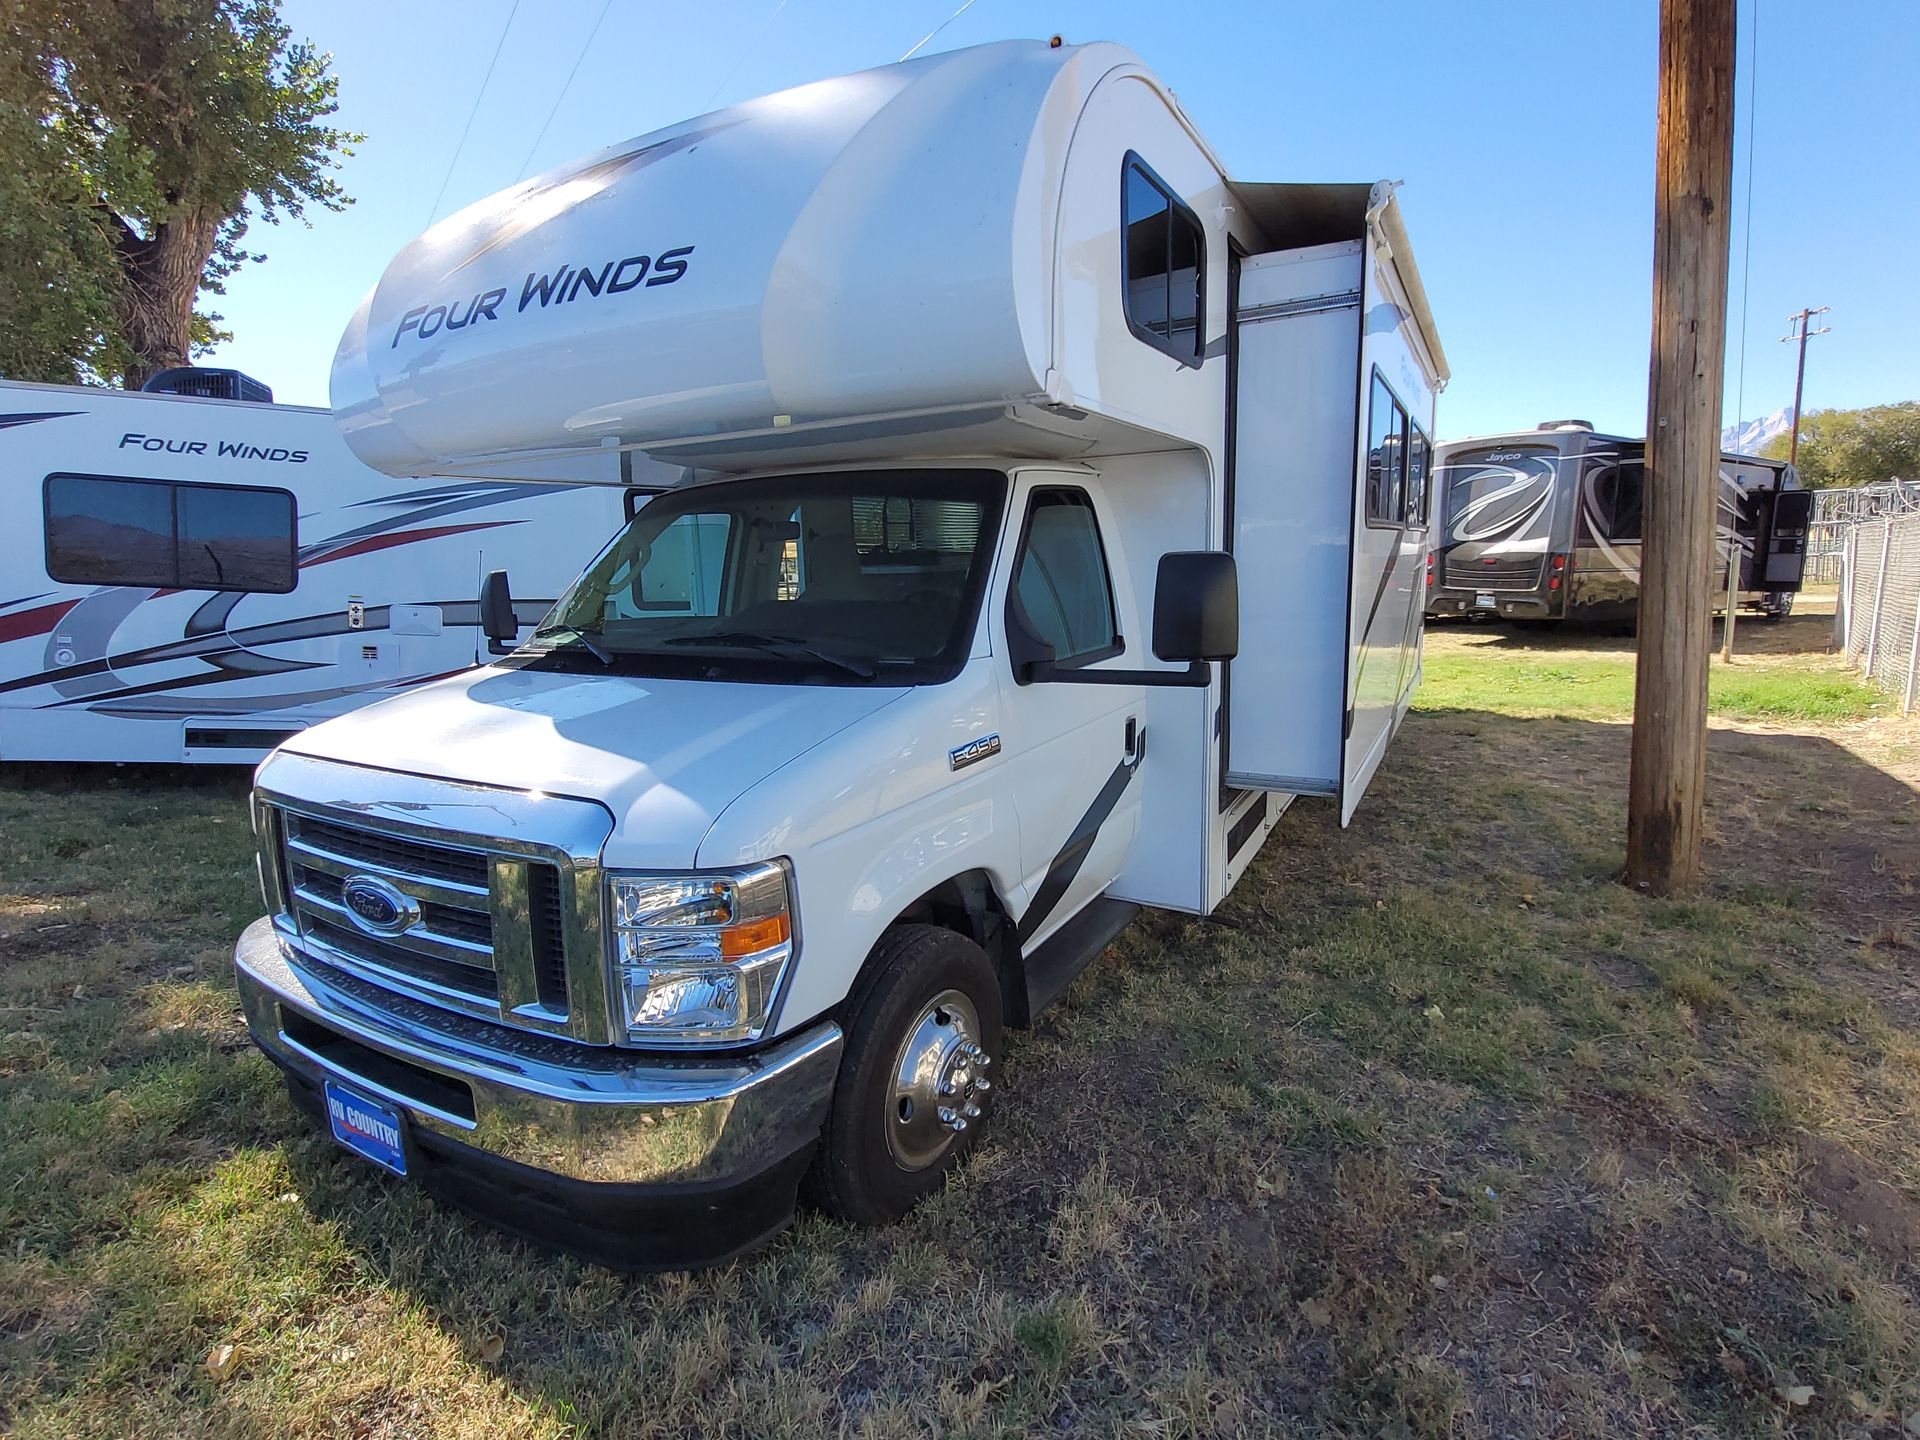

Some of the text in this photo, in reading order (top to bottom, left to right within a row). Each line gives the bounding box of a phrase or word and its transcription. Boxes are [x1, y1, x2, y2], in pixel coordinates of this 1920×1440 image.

[391, 246, 695, 349] FOUR WINDS
[118, 433, 310, 464] FOUR WINDS
[1485, 453, 1521, 463] Jayco
[353, 891, 384, 919] Ford
[329, 1097, 399, 1150] RV COUNTRY
